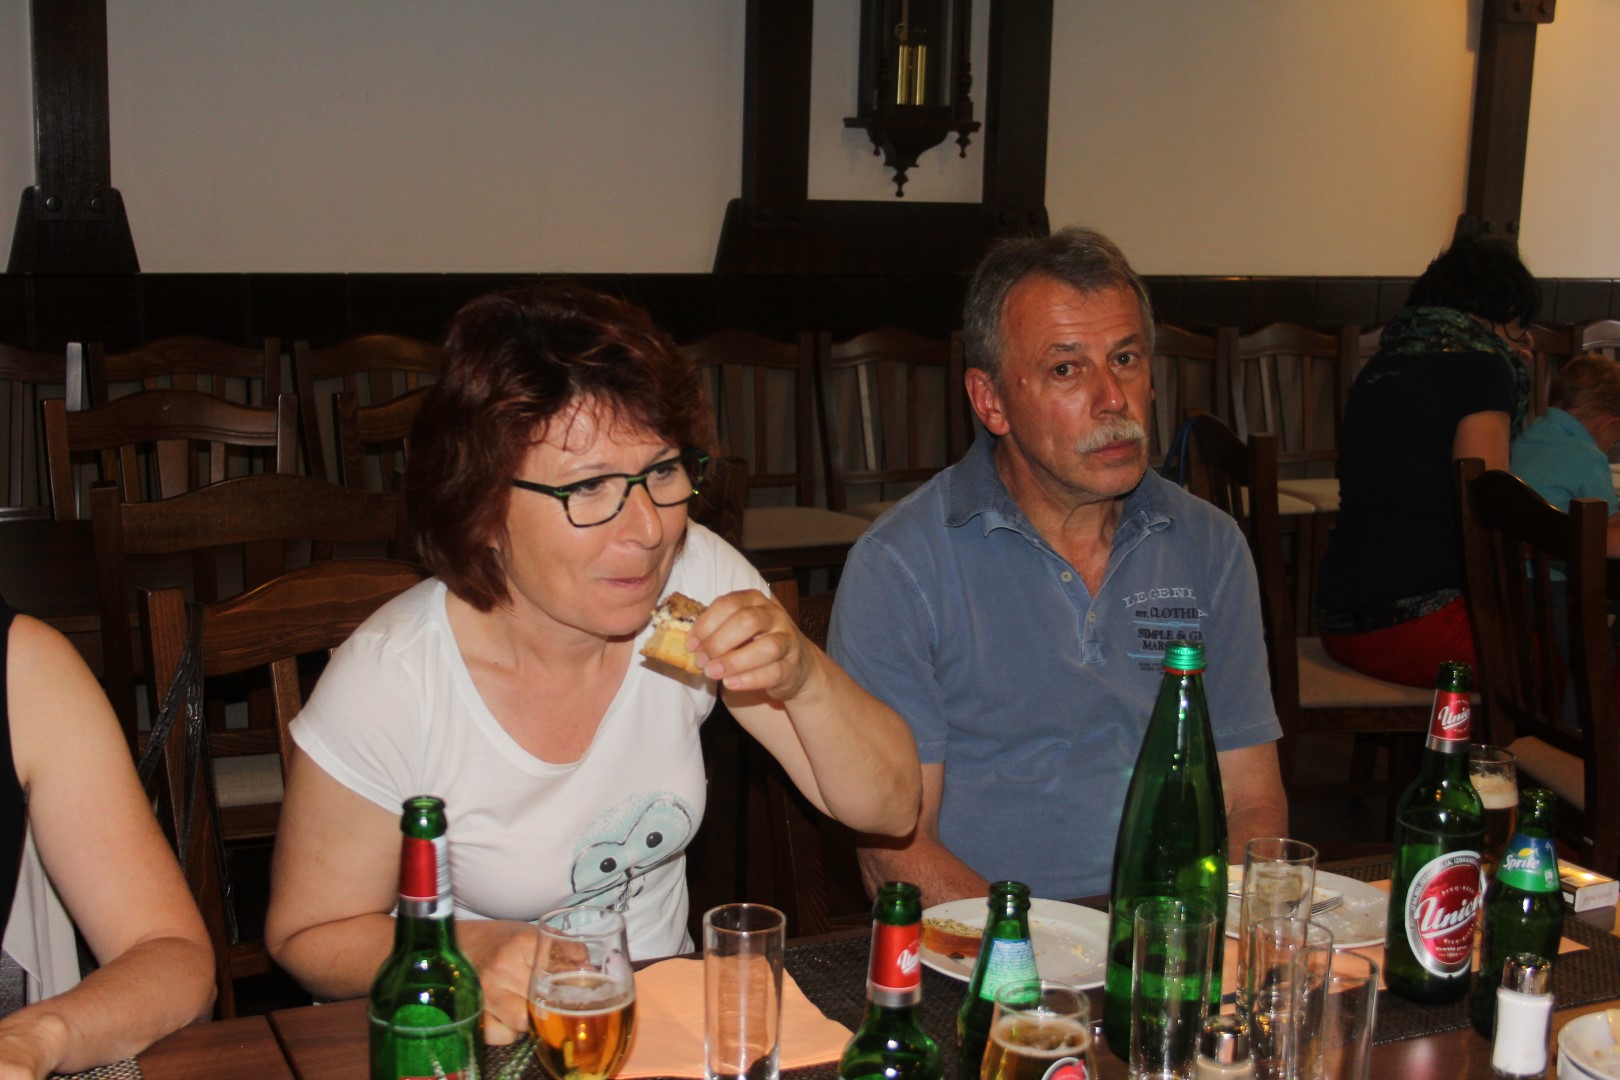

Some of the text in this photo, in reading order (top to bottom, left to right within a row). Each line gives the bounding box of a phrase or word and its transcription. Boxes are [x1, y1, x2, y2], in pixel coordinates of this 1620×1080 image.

[1138, 628, 1173, 640] SIMPLE
[1142, 640, 1165, 651] MAR
[1503, 855, 1540, 870] Sprite
